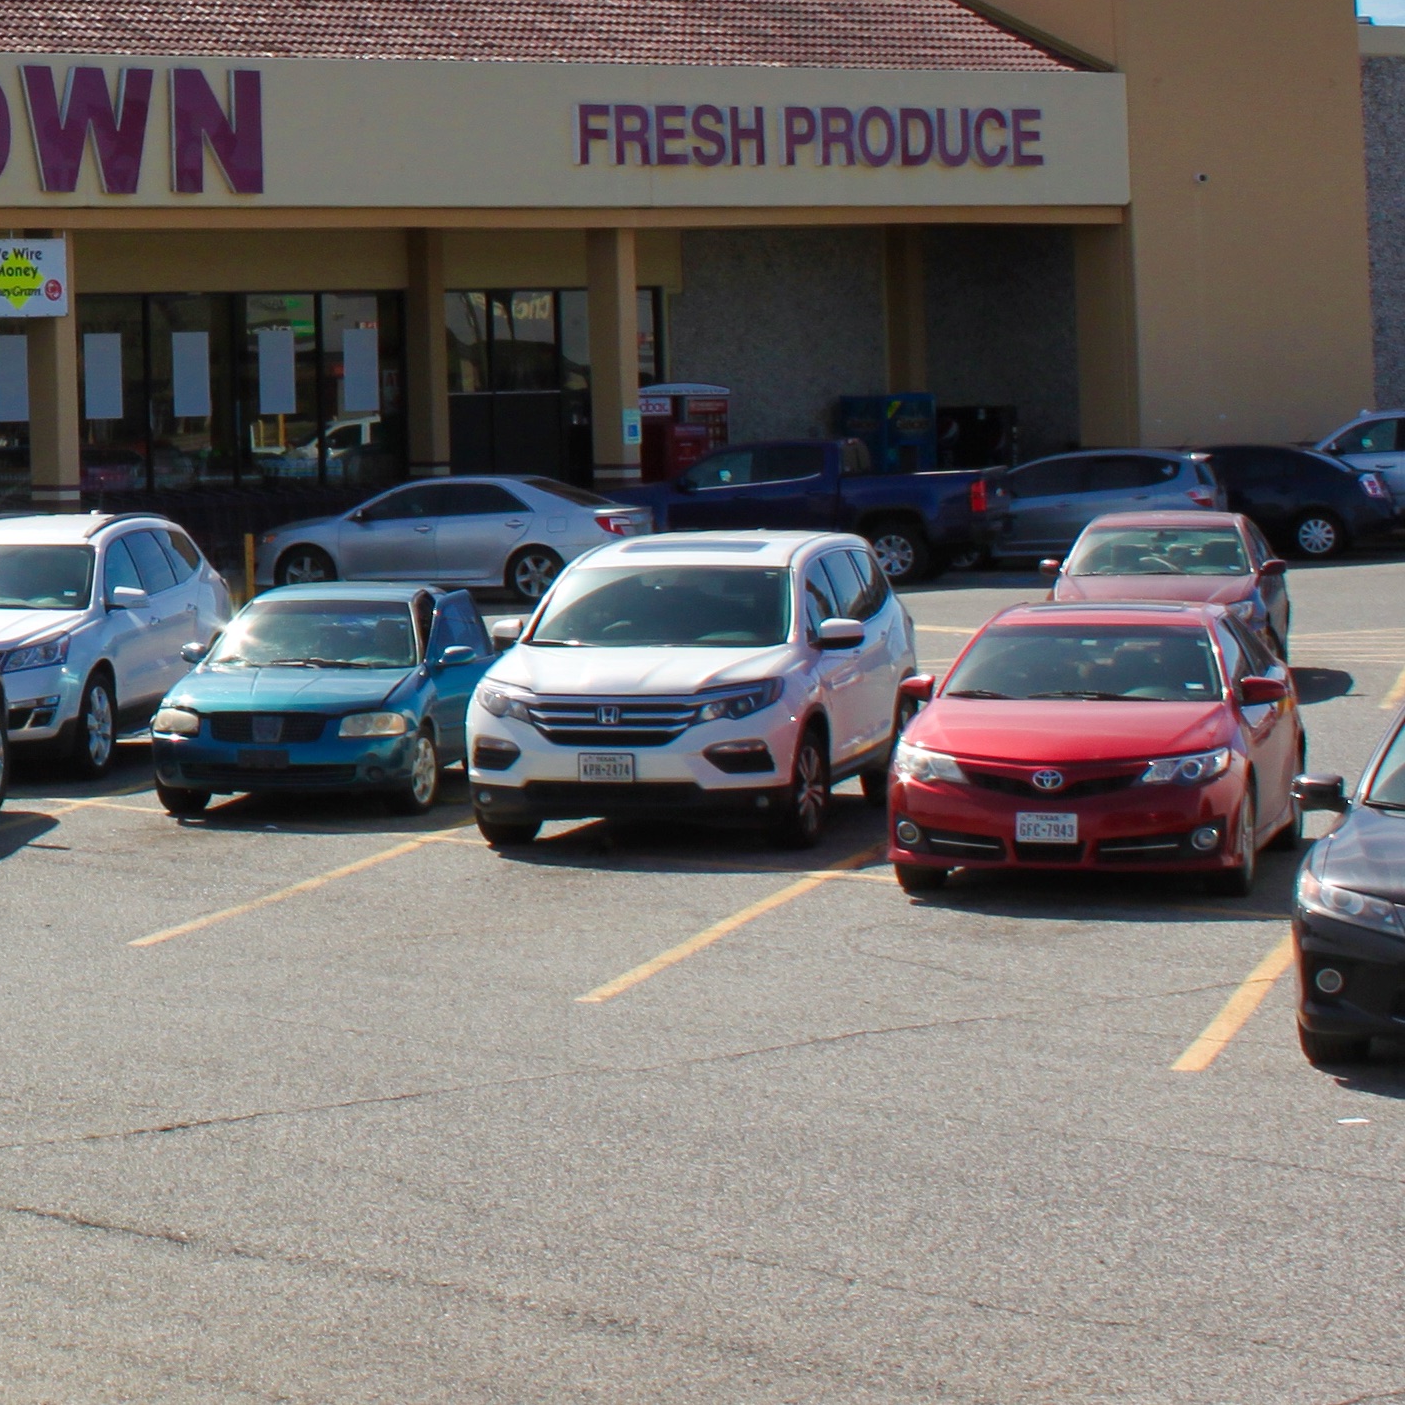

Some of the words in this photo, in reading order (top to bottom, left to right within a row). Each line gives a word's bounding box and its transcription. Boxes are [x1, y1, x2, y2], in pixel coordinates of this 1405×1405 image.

[574, 103, 766, 167] FRESH
[781, 105, 1046, 169] PRODUCE
[12, 248, 42, 260] Wire
